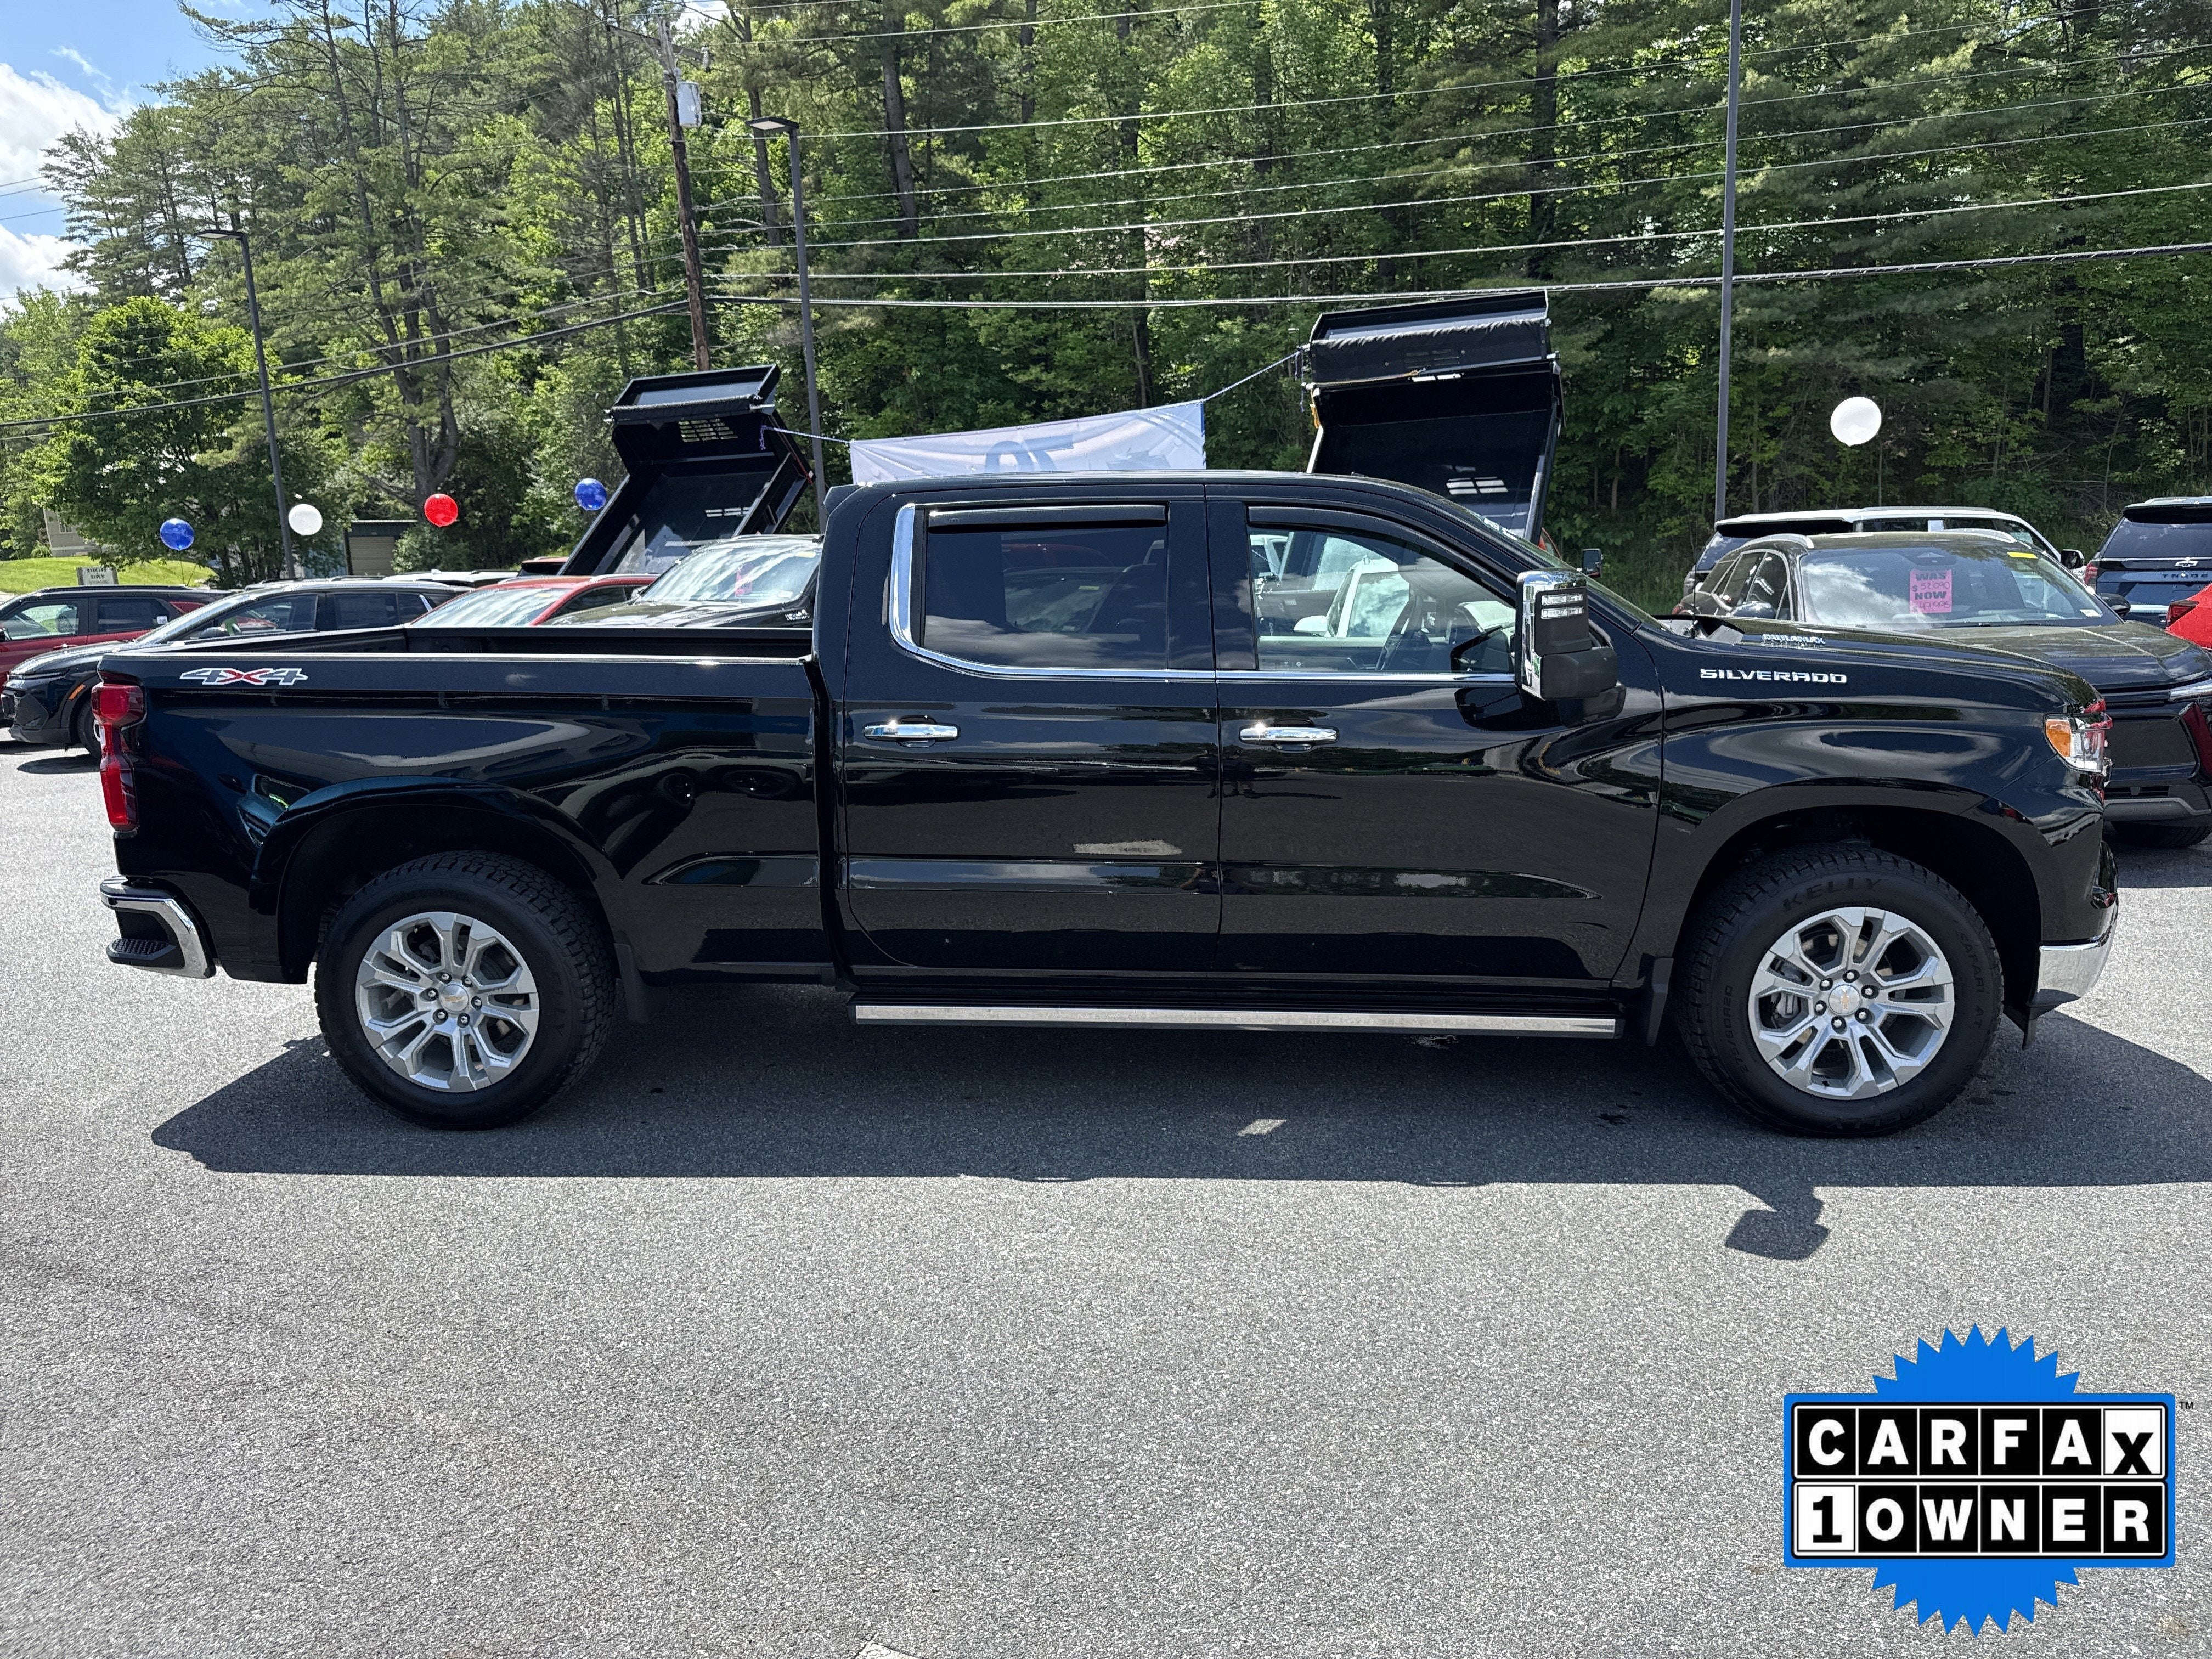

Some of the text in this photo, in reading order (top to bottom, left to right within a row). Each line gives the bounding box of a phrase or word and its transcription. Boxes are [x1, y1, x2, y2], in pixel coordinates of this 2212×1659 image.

[1915, 572, 1946, 580] WAS
[1915, 591, 1946, 600] NOW
[1762, 634, 1826, 644] DURAMAX
[1700, 669, 1847, 683] SILVERADO
[1783, 878, 1882, 912] KELLY
[1955, 933, 1984, 993] SAFARI
